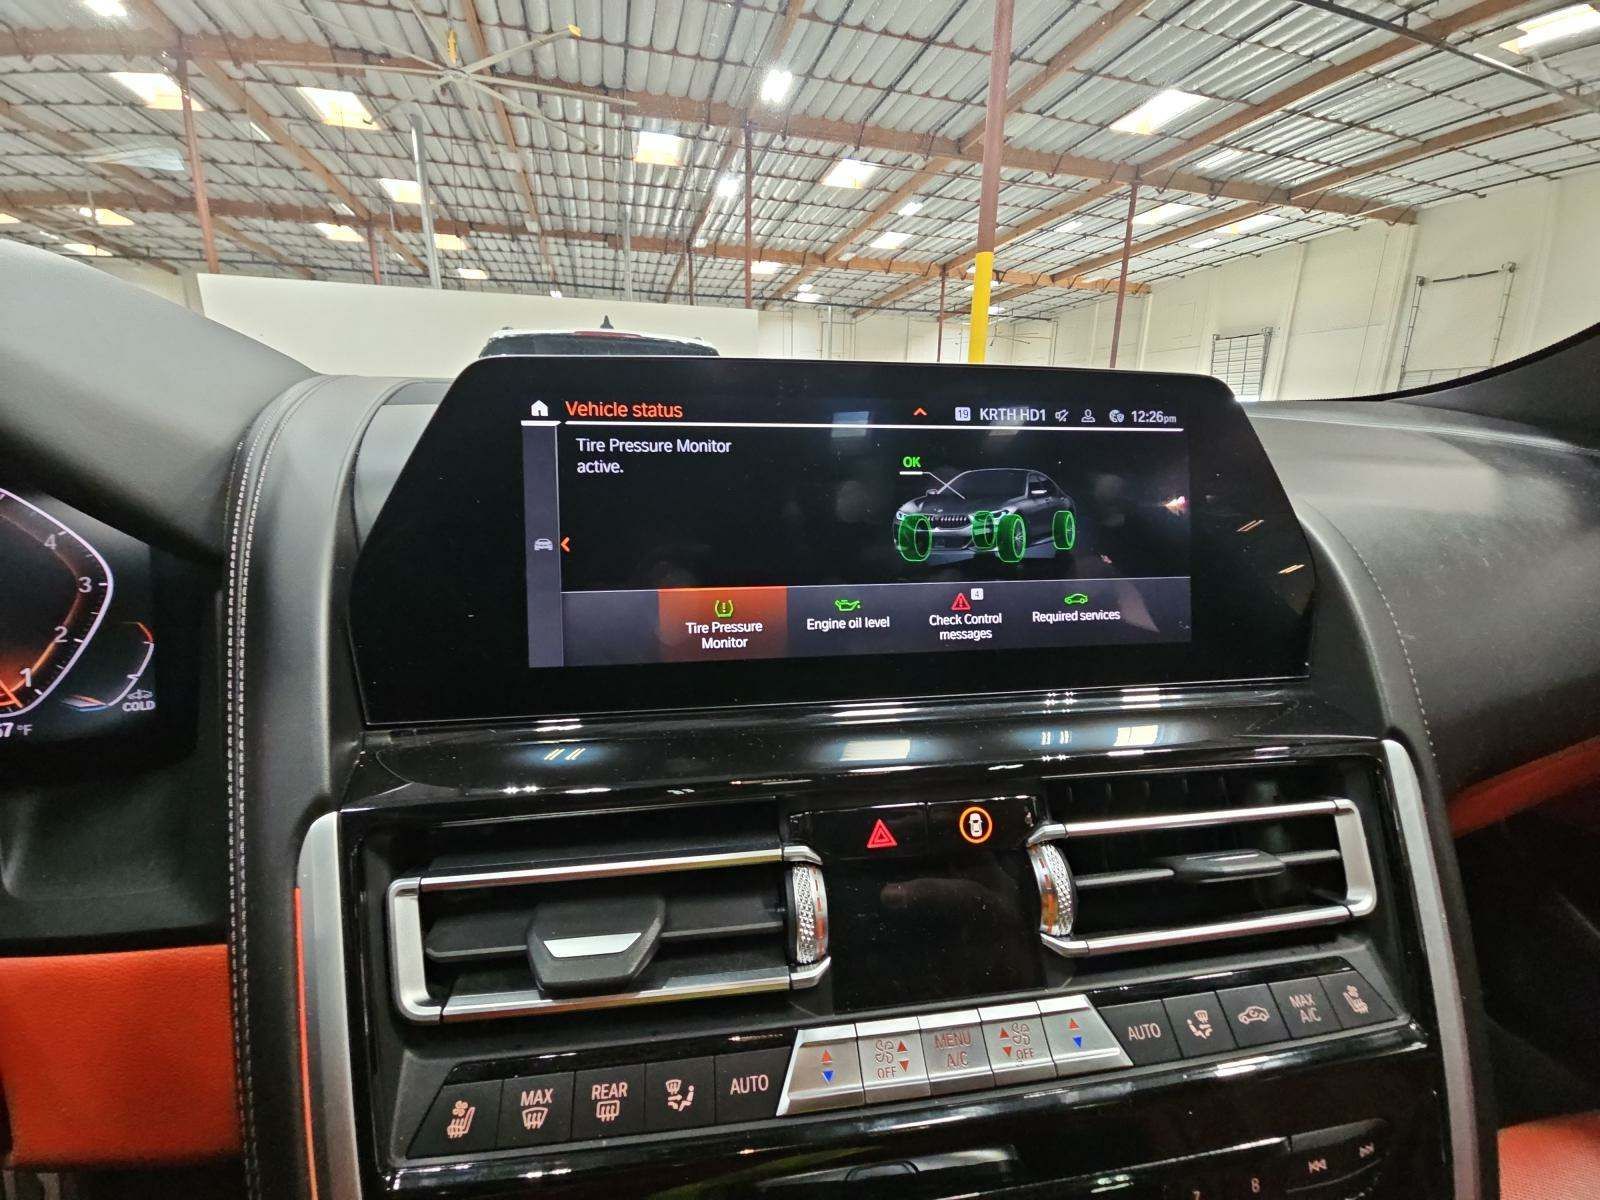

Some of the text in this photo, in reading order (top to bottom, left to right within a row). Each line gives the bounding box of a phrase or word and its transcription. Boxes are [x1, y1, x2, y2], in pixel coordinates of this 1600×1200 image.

[565, 400, 683, 418] Vehicle status
[980, 408, 1046, 422] KRTH HD1
[1131, 410, 1177, 424] 12:26pm
[575, 438, 732, 454] Tire Pressure Monitor
[576, 460, 624, 475] active.
[902, 456, 921, 468] OK
[43, 533, 57, 550] 4
[78, 576, 92, 593] 3
[806, 616, 890, 632] Engine oil level
[928, 612, 1002, 626] Check Control
[1032, 609, 1121, 625] Required services
[54, 626, 68, 643] 2
[685, 620, 763, 634] Tire Pressure
[939, 628, 993, 642] messages
[701, 636, 749, 650] Monitor
[20, 667, 32, 687] 1
[121, 700, 156, 712] COLD
[1288, 993, 1314, 1009] MAX
[1300, 1007, 1321, 1024] A/C
[1127, 1022, 1162, 1041] AUTO
[934, 1030, 971, 1050] MENU
[946, 1051, 968, 1068] A/C
[1015, 1047, 1035, 1062] OFF
[877, 1065, 897, 1080] OFF
[591, 1081, 628, 1100] REAR
[730, 1073, 769, 1096] AUTO
[520, 1087, 554, 1107] MAX
